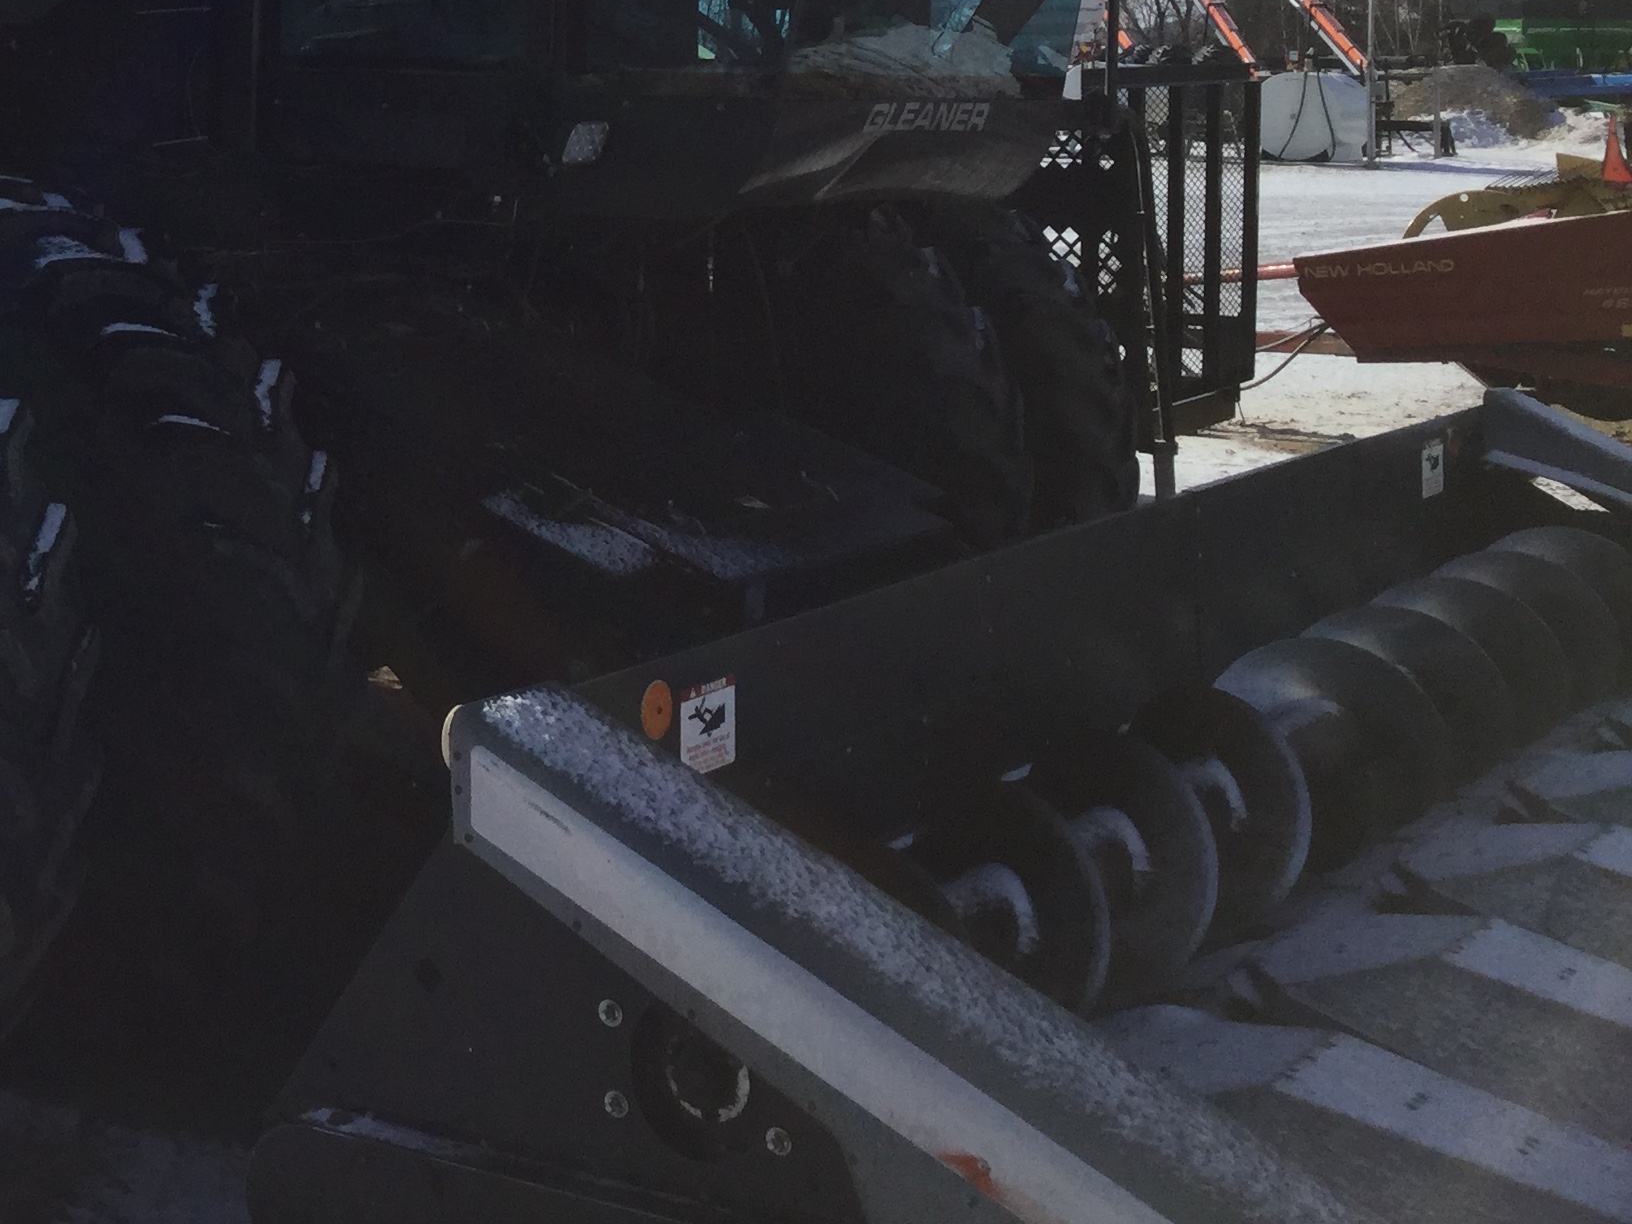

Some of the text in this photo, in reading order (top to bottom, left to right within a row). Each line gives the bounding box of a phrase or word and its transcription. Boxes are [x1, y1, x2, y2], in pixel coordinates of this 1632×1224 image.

[863, 102, 991, 132] GLEANER
[1304, 259, 1456, 278] NEW HOLLAND
